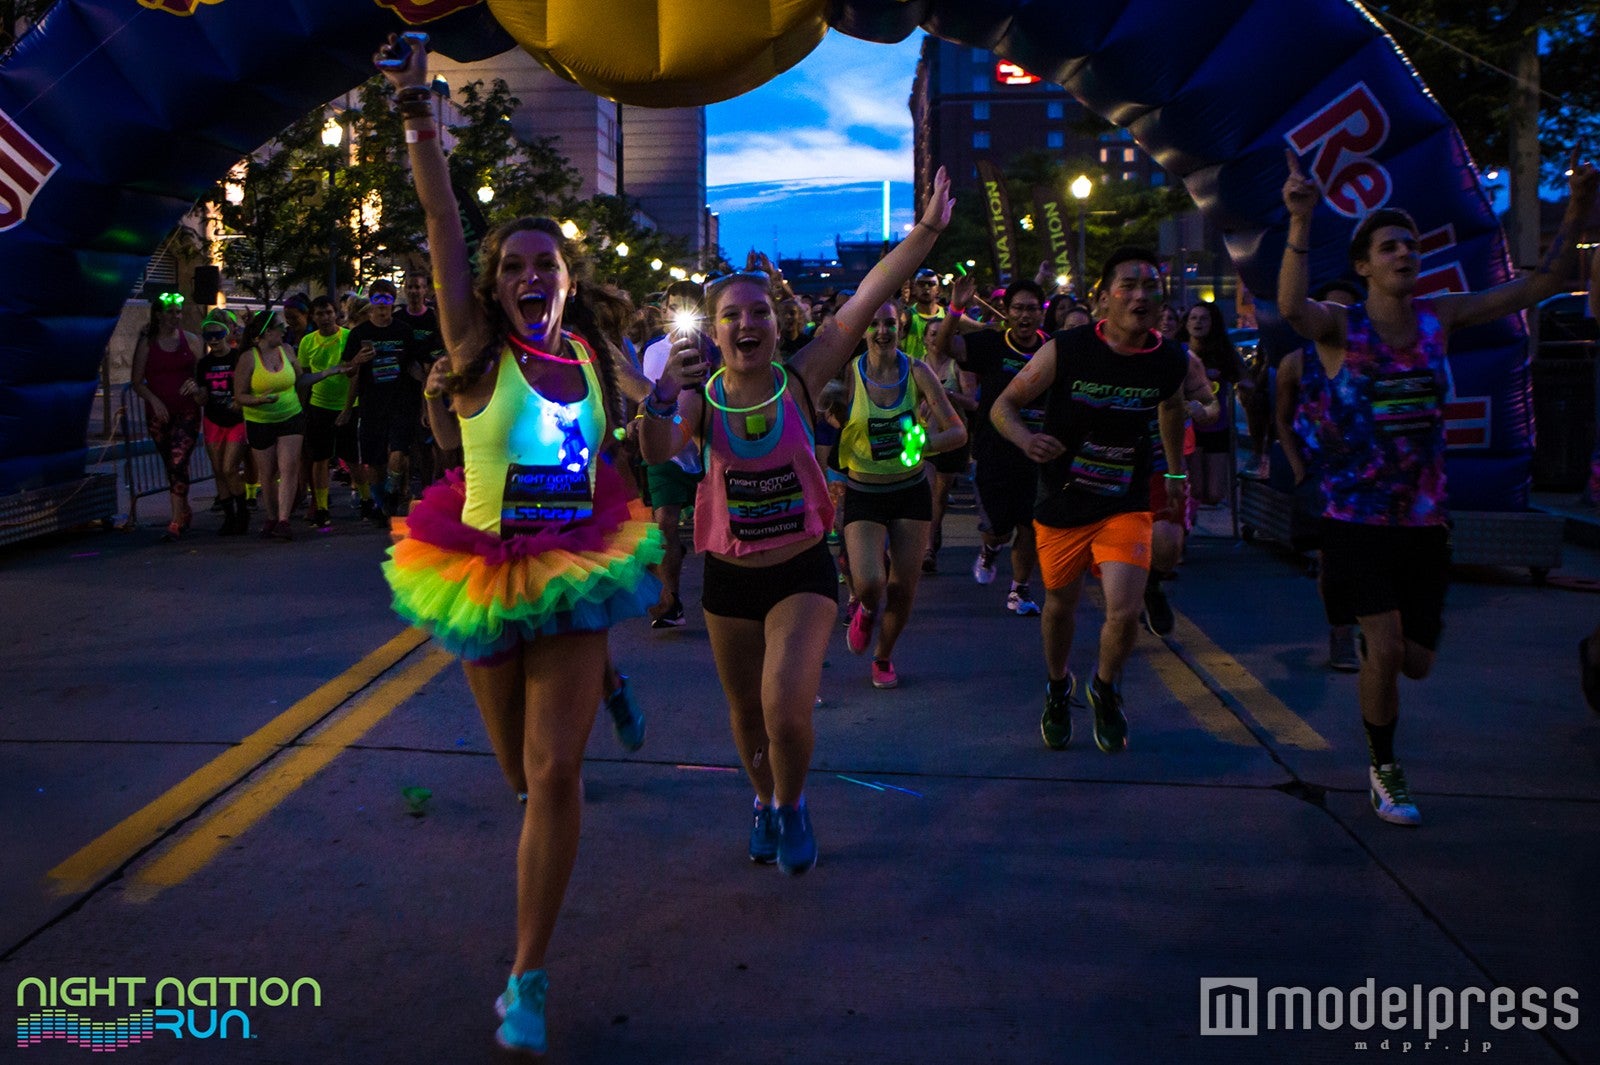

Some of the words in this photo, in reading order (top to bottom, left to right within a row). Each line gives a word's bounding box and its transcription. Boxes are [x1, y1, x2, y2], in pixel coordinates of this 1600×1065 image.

[985, 181, 1012, 269] NATION
[1072, 379, 1113, 396] NIGHT
[511, 473, 546, 484] NIGHT
[729, 478, 758, 487] NIGHT
[759, 471, 796, 487] NATION
[739, 521, 798, 535] #NIGHTNATION
